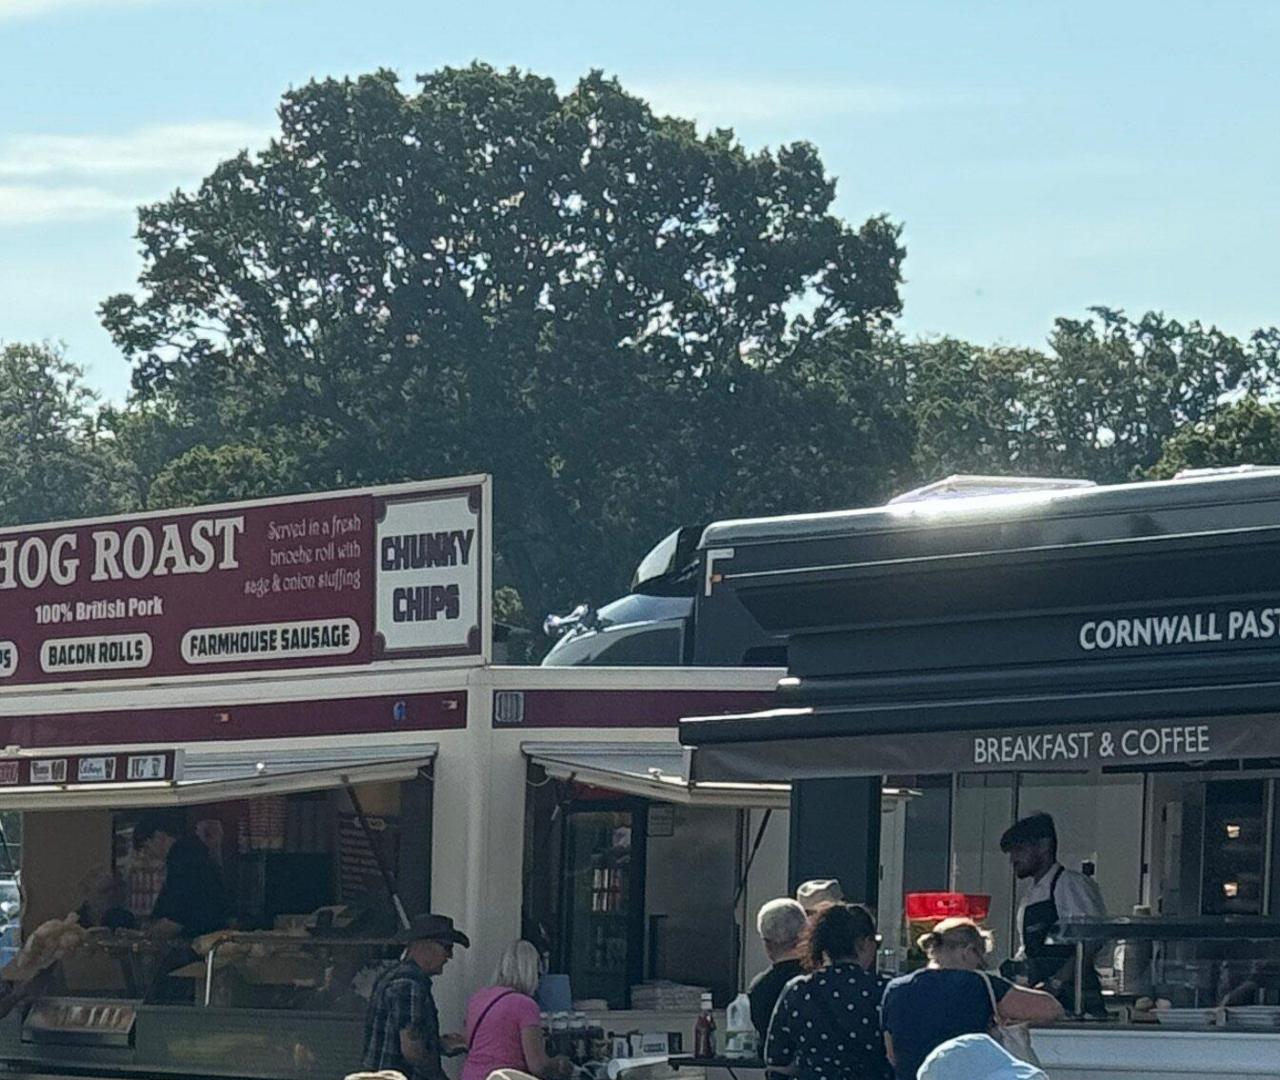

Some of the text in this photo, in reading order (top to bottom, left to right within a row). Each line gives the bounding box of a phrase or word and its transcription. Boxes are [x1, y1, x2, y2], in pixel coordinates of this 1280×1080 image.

[91, 516, 244, 581] ROAST
[315, 542, 334, 561] roll
[381, 529, 474, 571] CHUNKY
[35, 595, 164, 624] 100% British Pork
[393, 584, 460, 623] CHIPS
[190, 623, 351, 657] FARMHOUSE SAUSAGE
[1079, 612, 1223, 650] CORNWALL
[48, 639, 144, 666] BACON ROLLS
[973, 726, 1210, 764] BREAKFAST & COFFEE
